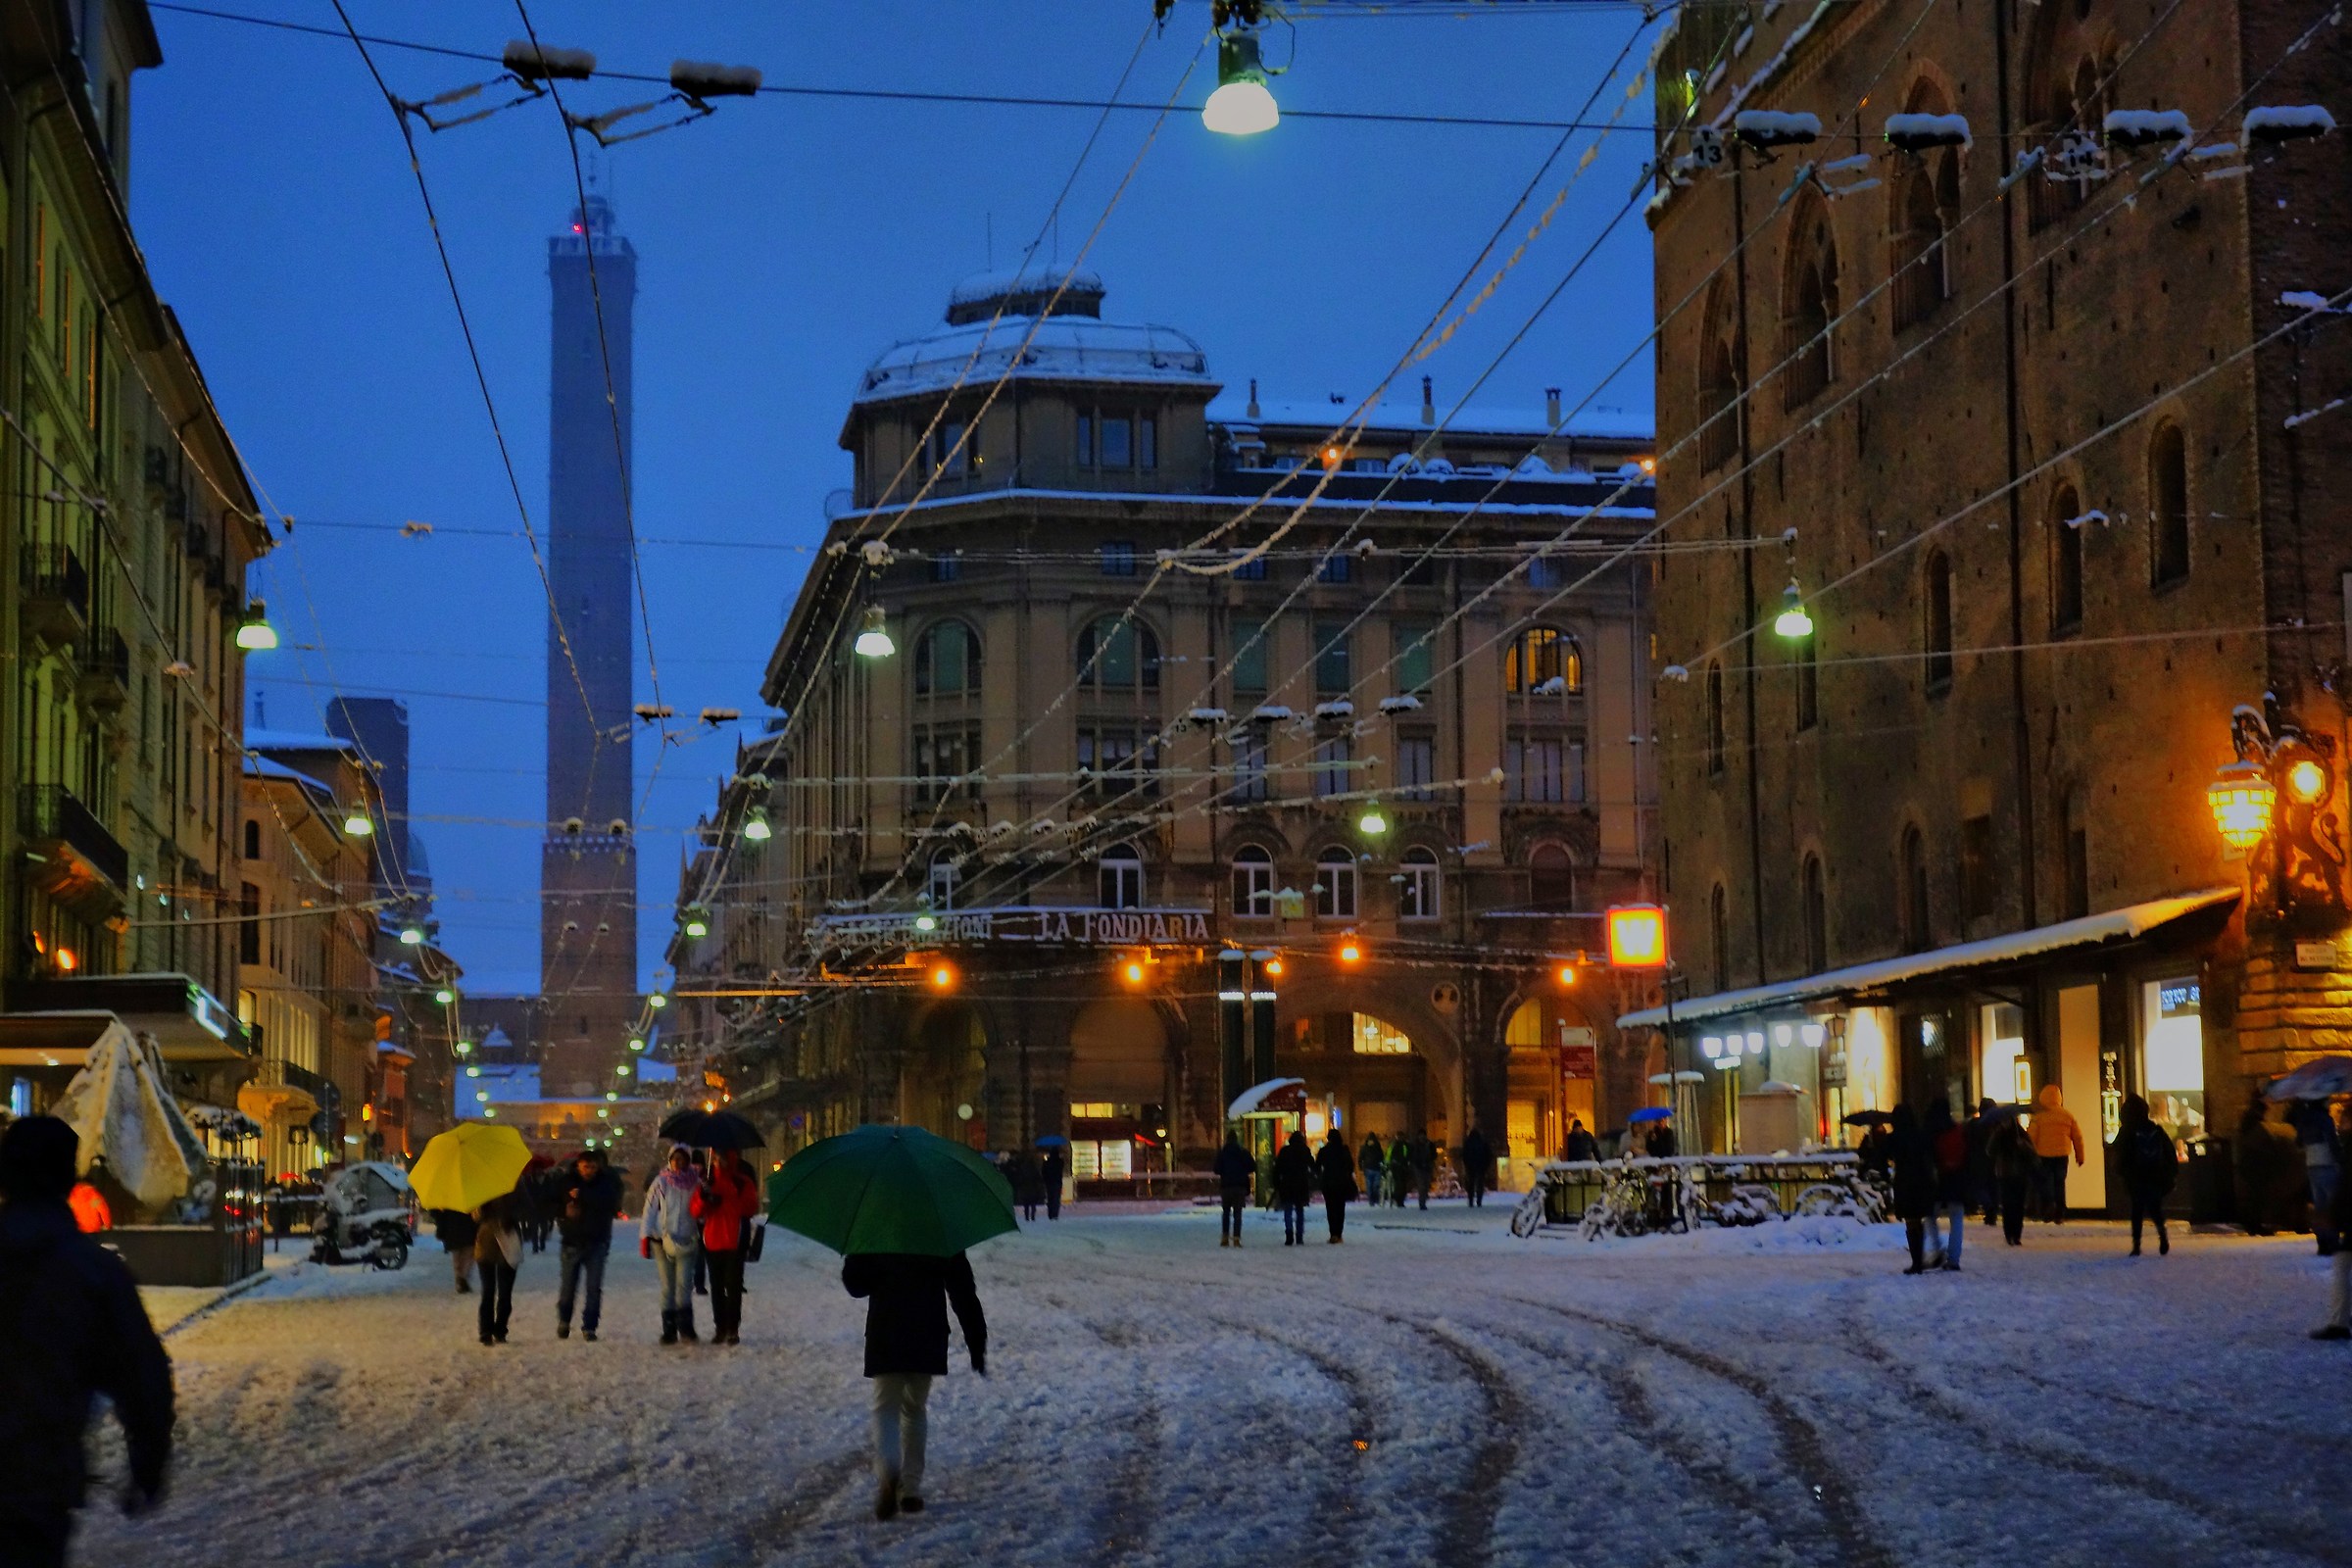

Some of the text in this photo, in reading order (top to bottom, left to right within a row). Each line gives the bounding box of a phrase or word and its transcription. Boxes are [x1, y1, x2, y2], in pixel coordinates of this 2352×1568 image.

[1693, 145, 1722, 163] 13
[1041, 911, 1072, 942] LA
[1082, 911, 1211, 943] FONDIARIA
